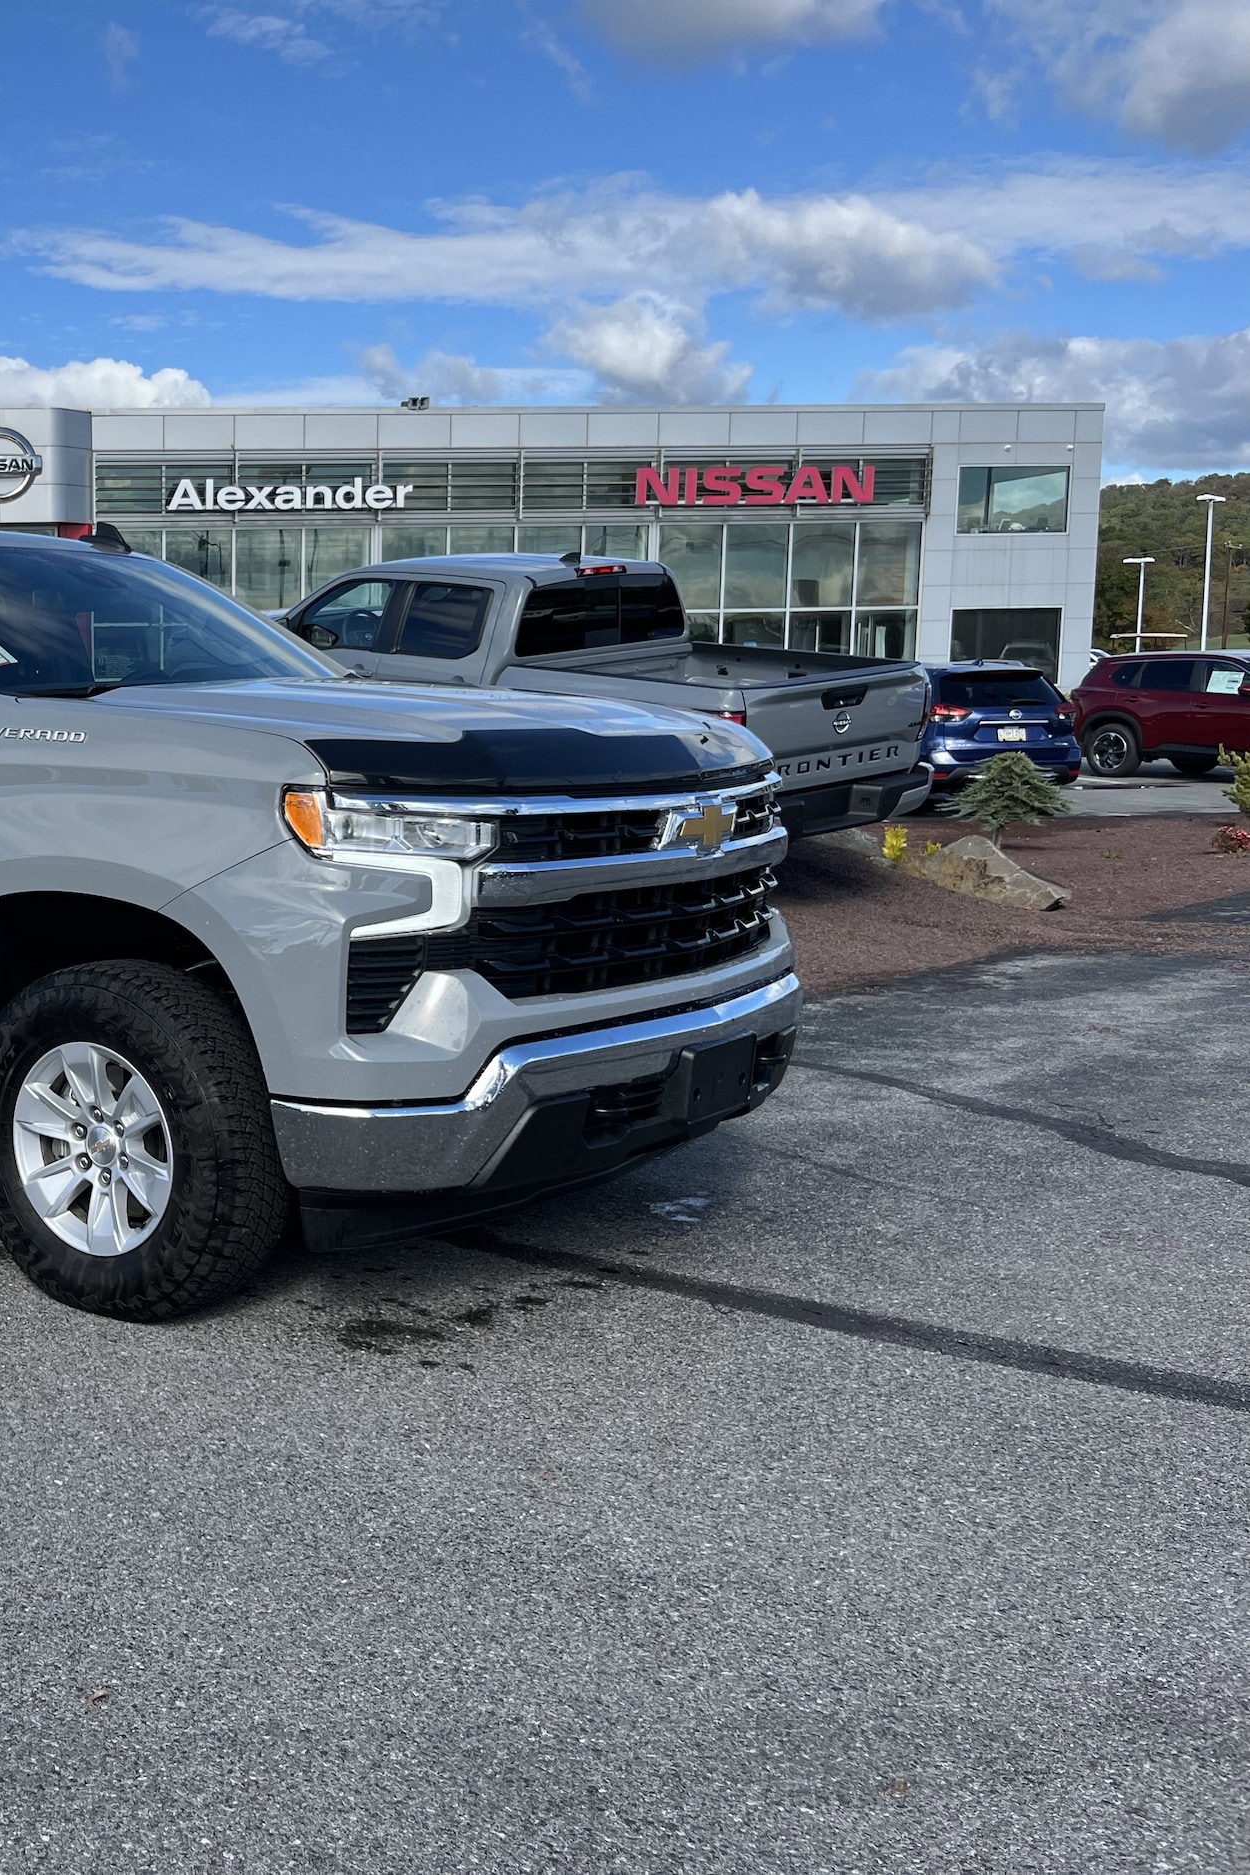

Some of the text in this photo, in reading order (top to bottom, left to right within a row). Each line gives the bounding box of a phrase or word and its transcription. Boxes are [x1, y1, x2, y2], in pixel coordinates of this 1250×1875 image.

[167, 477, 413, 511] Alexander
[635, 465, 876, 505] NISSAN
[777, 745, 899, 776] RONTIER
